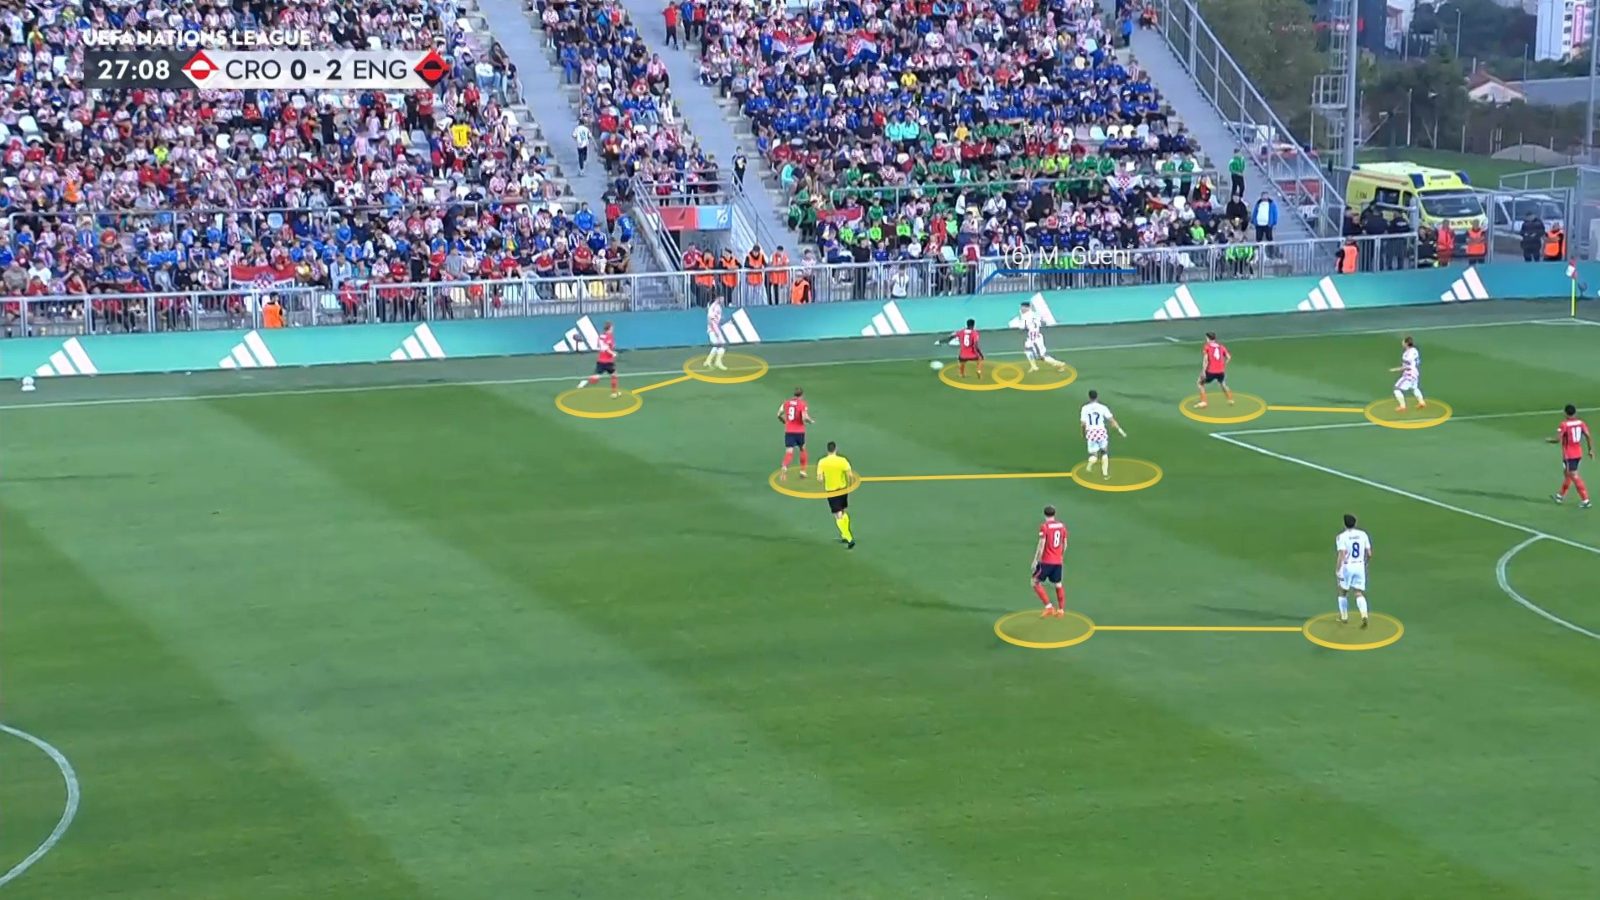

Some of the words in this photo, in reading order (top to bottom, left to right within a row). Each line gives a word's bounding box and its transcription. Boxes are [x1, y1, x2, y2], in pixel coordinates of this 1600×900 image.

[963, 334, 971, 347] 6
[788, 406, 795, 421] 9
[1087, 411, 1101, 426] 17
[1053, 529, 1061, 548] 8
[1352, 542, 1360, 558] 8
